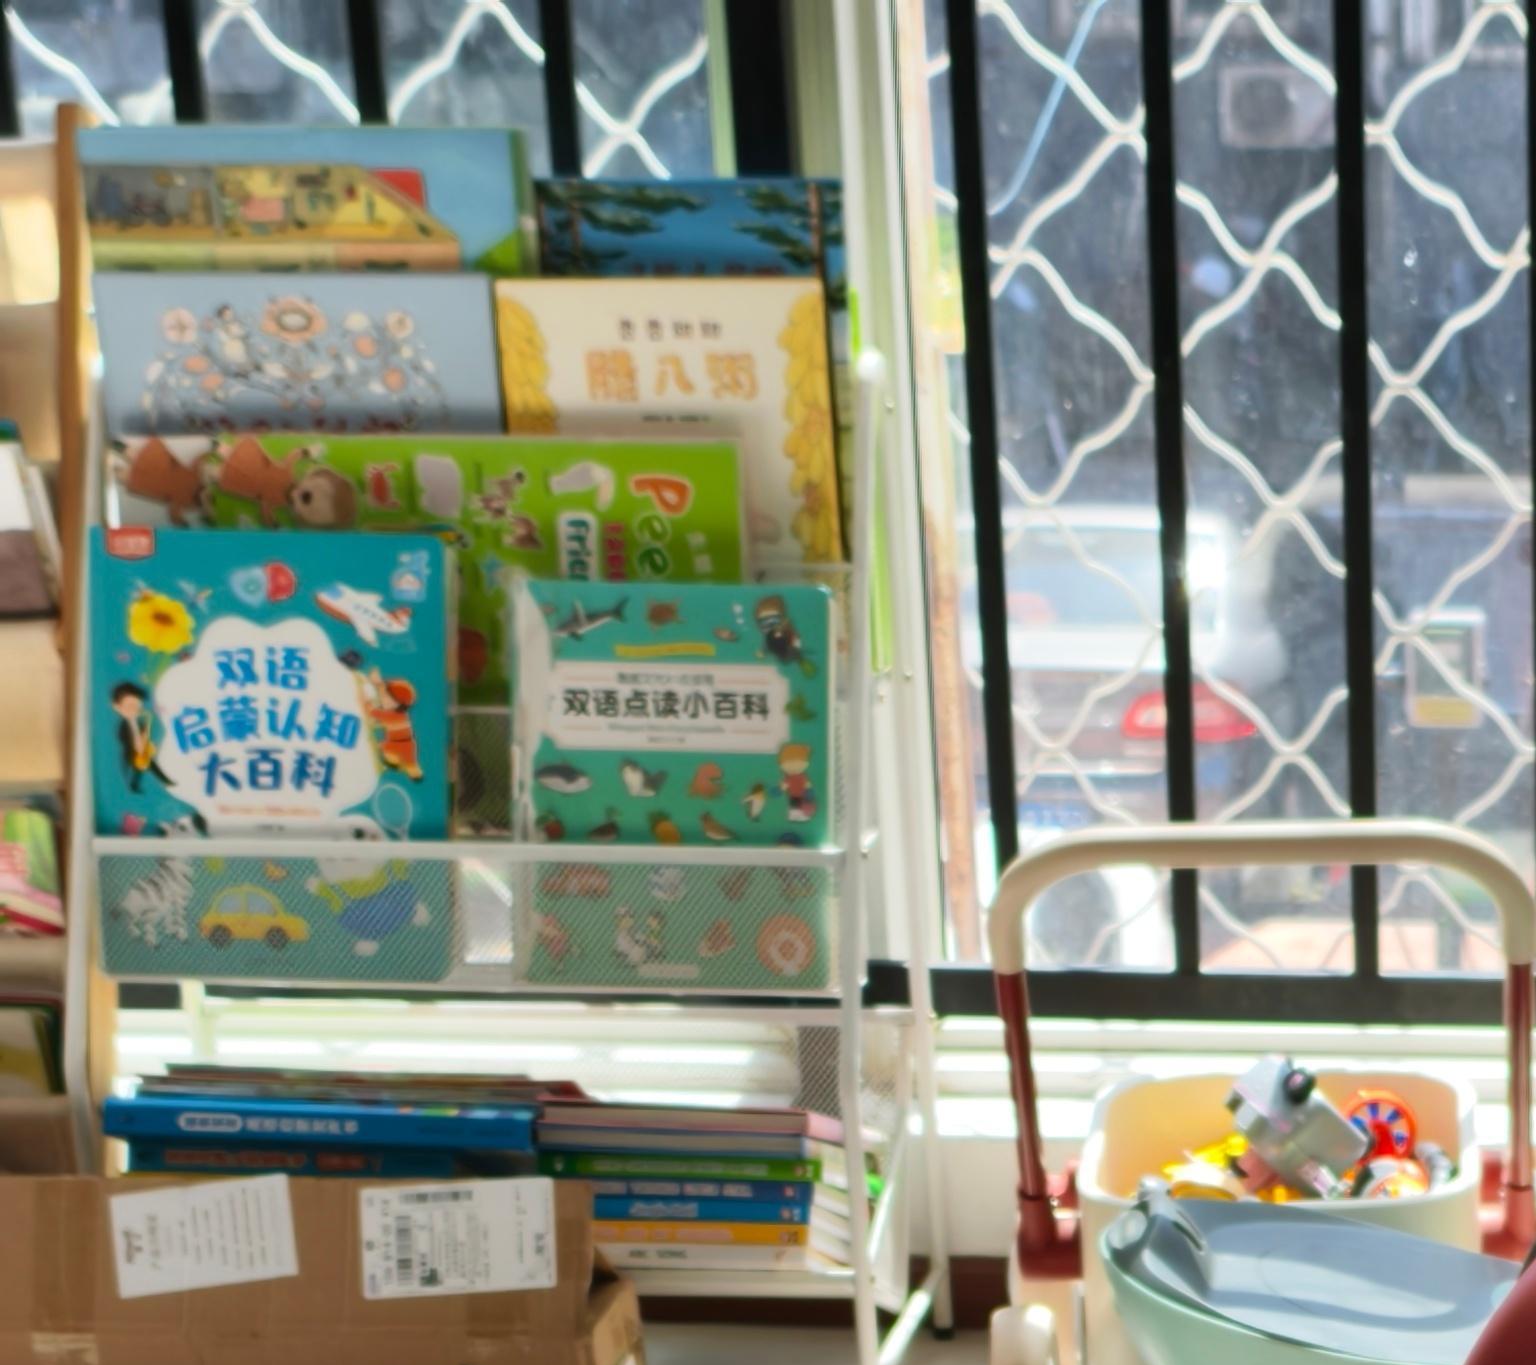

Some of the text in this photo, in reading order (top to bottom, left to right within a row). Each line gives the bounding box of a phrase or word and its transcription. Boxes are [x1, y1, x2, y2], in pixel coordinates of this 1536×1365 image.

[213, 647, 309, 691] 双语
[171, 697, 361, 754] 启蒙认知
[562, 687, 770, 720] 双语点读小百科
[198, 746, 337, 798] 大百科
